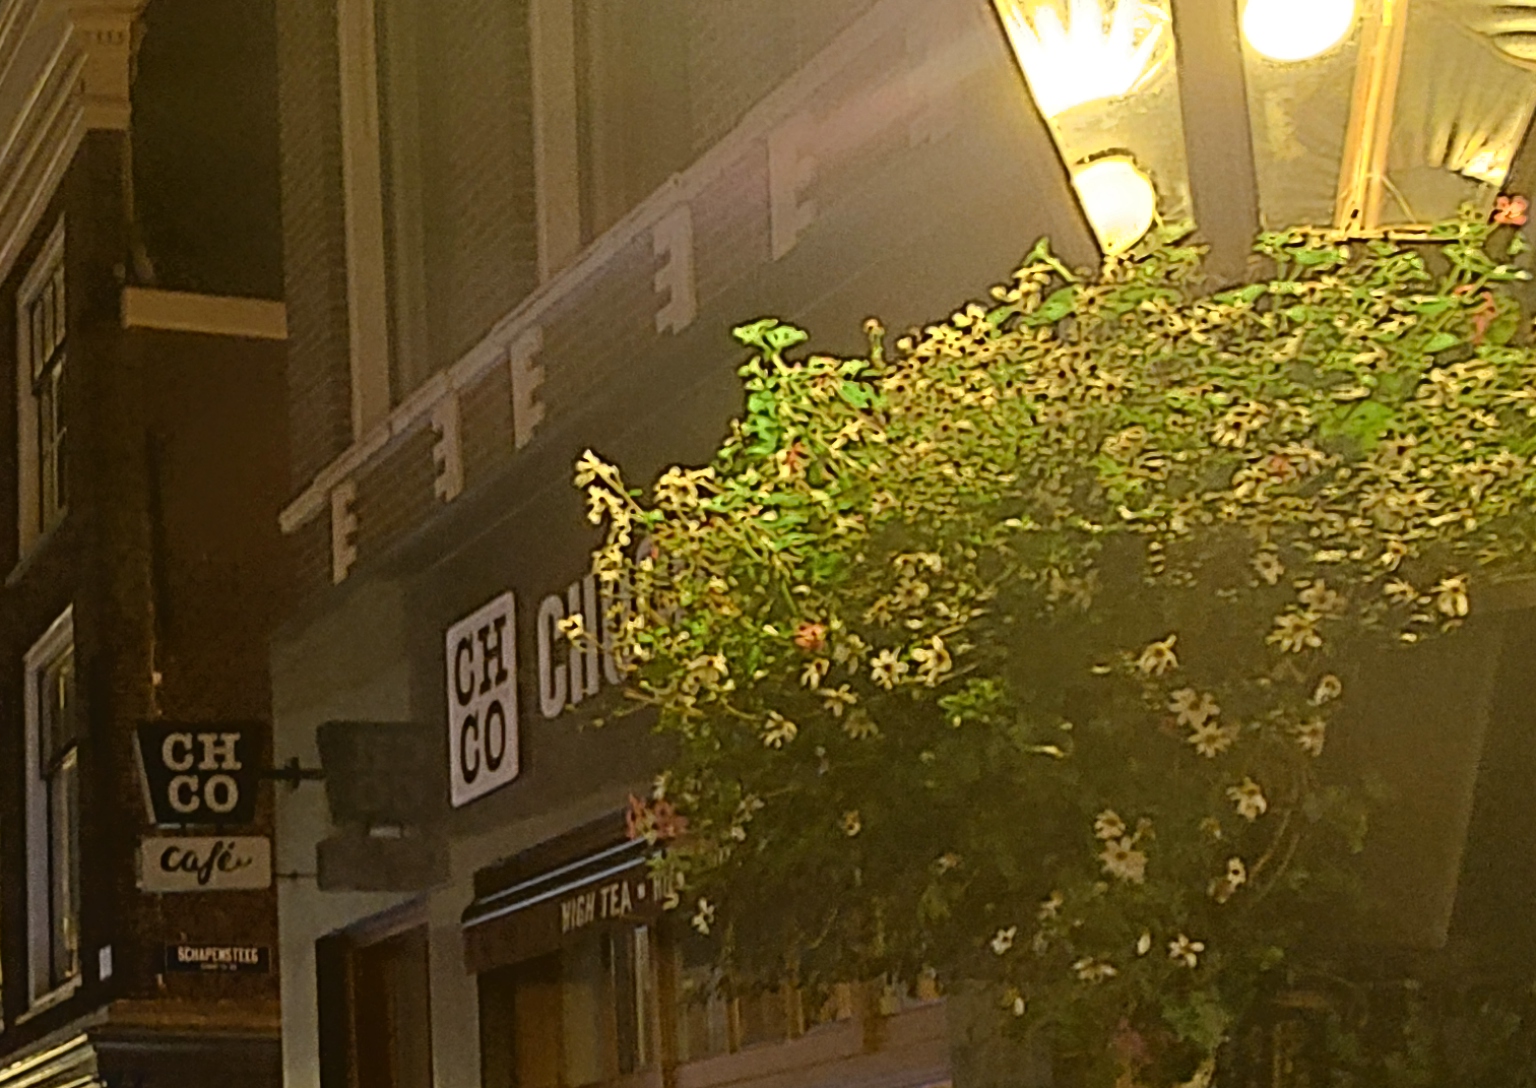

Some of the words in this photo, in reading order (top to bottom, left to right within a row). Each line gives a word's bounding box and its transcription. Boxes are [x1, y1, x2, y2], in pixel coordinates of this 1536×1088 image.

[454, 615, 508, 707] CH
[162, 732, 243, 772] CH
[459, 700, 506, 785] CO
[168, 774, 239, 813] CO
[160, 840, 253, 886] café
[561, 891, 596, 934] HIGH
[600, 879, 633, 919] TEA
